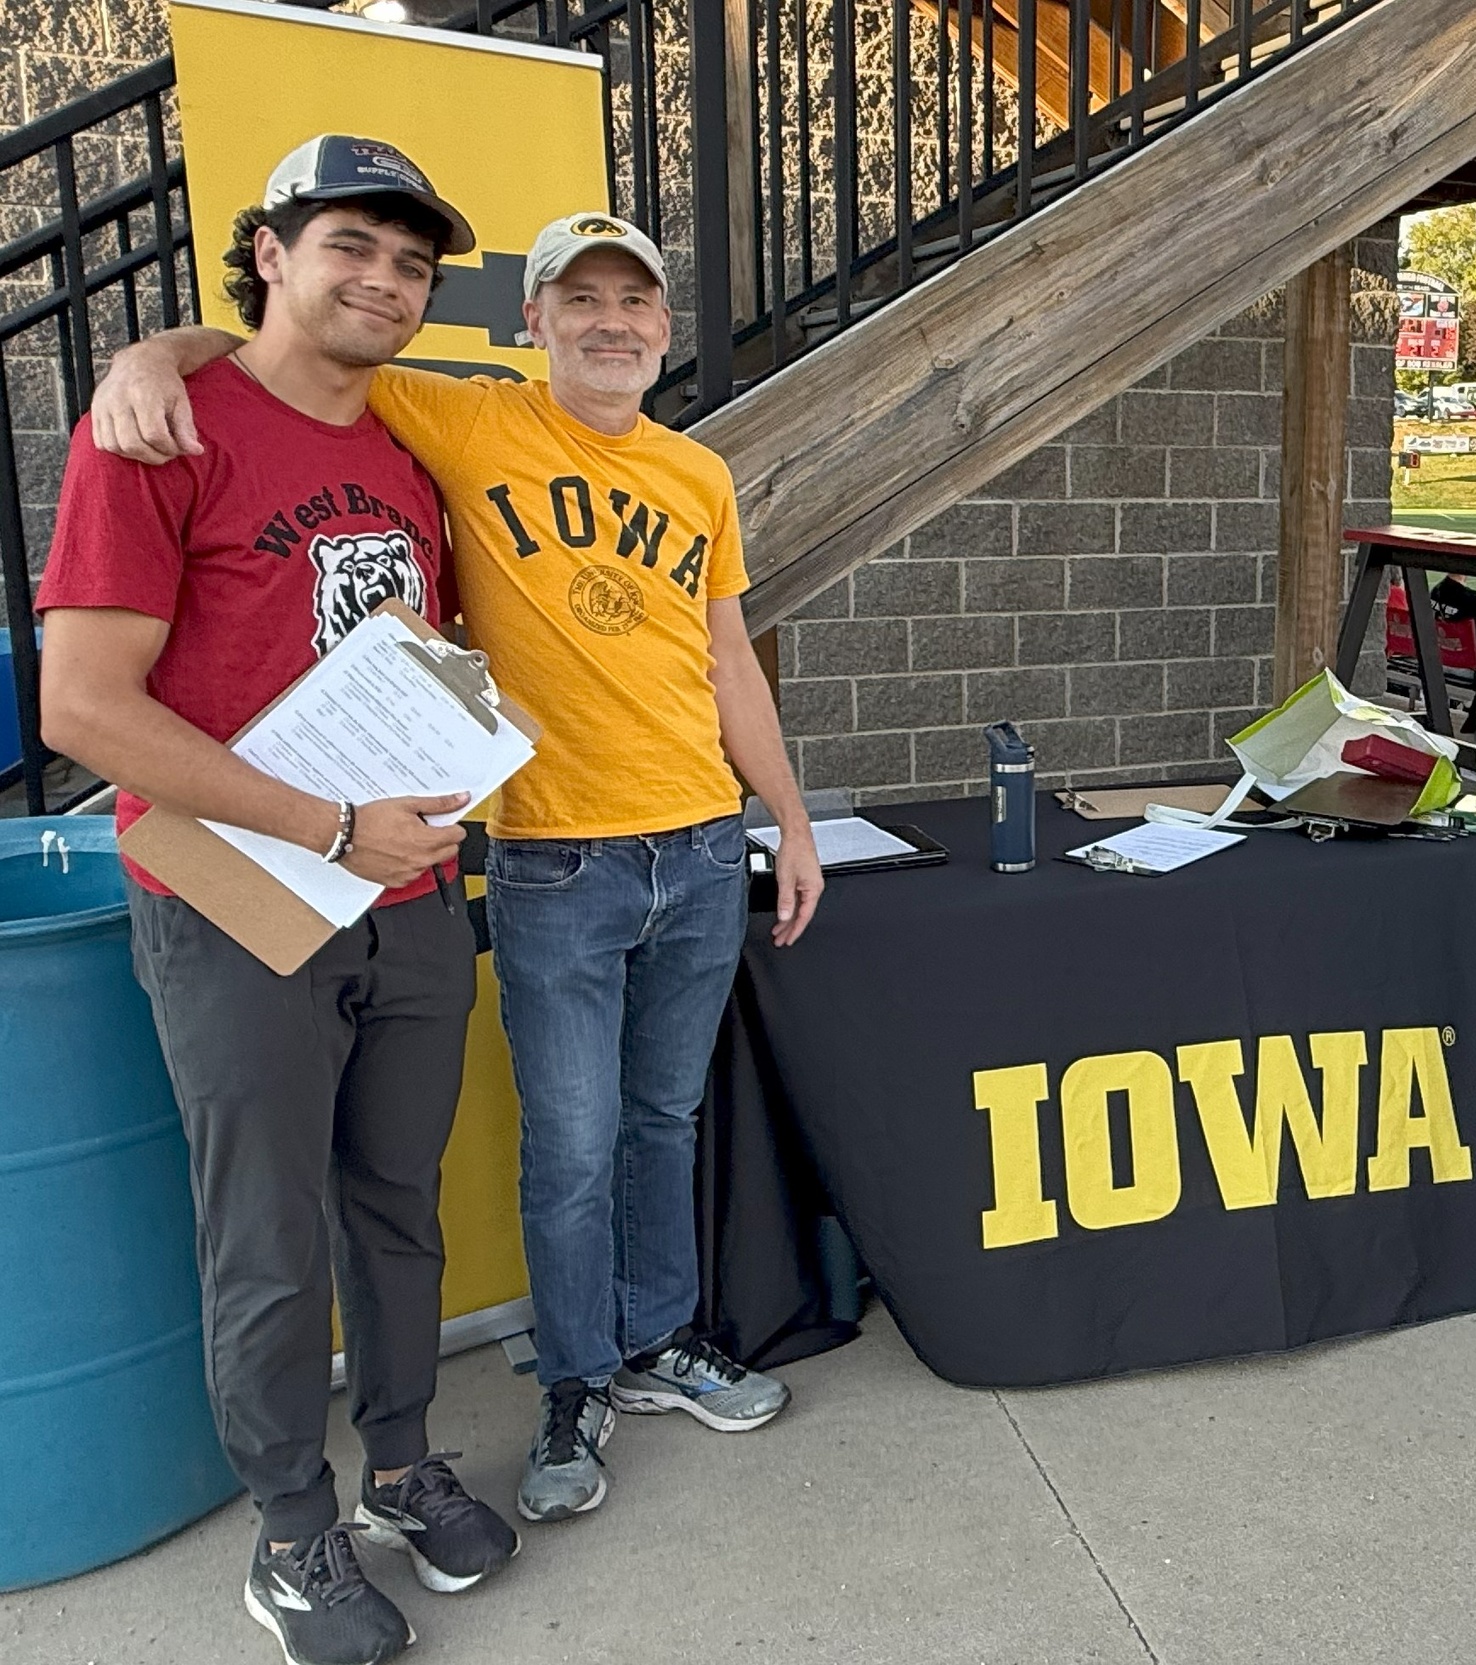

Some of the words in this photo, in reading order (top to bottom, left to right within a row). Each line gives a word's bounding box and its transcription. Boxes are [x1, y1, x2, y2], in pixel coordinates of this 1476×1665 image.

[254, 486, 342, 559] West
[341, 483, 434, 559] Branc
[486, 475, 708, 599] IOWA
[973, 1027, 1473, 1249] IOWA
